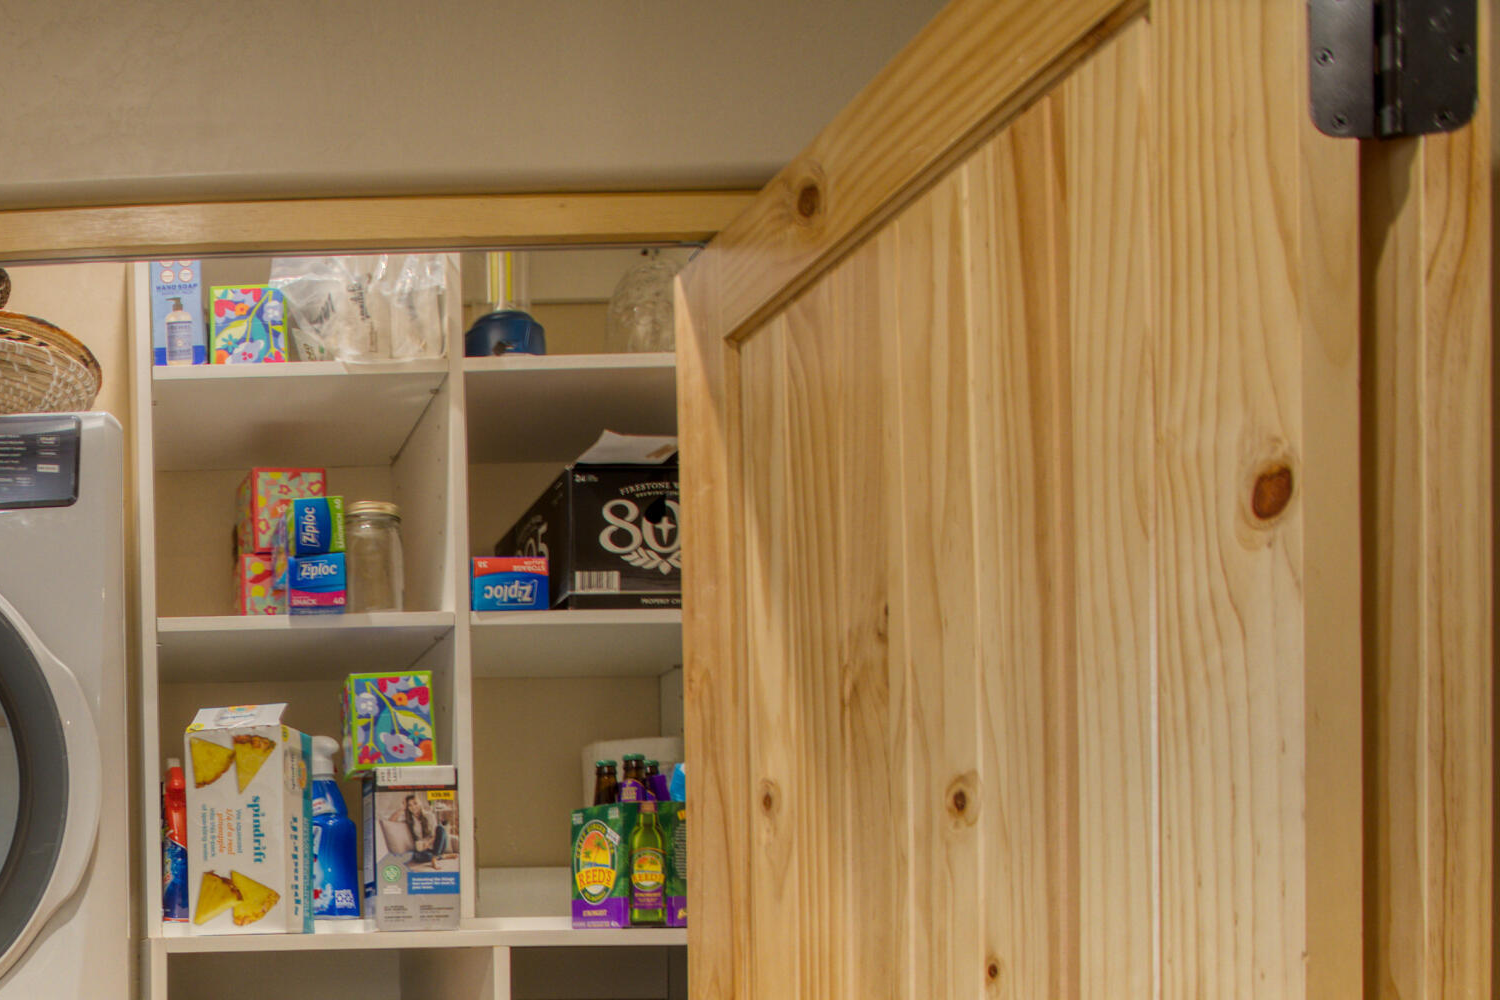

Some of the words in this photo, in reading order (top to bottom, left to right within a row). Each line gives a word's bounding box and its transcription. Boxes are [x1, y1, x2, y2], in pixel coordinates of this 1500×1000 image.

[619, 481, 671, 497] FIRESTONE
[301, 507, 320, 545] Ziploc
[301, 561, 338, 579] Ziploc
[484, 580, 533, 602] Ziploc
[246, 795, 266, 863] spindrift
[578, 869, 613, 890] REED'S
